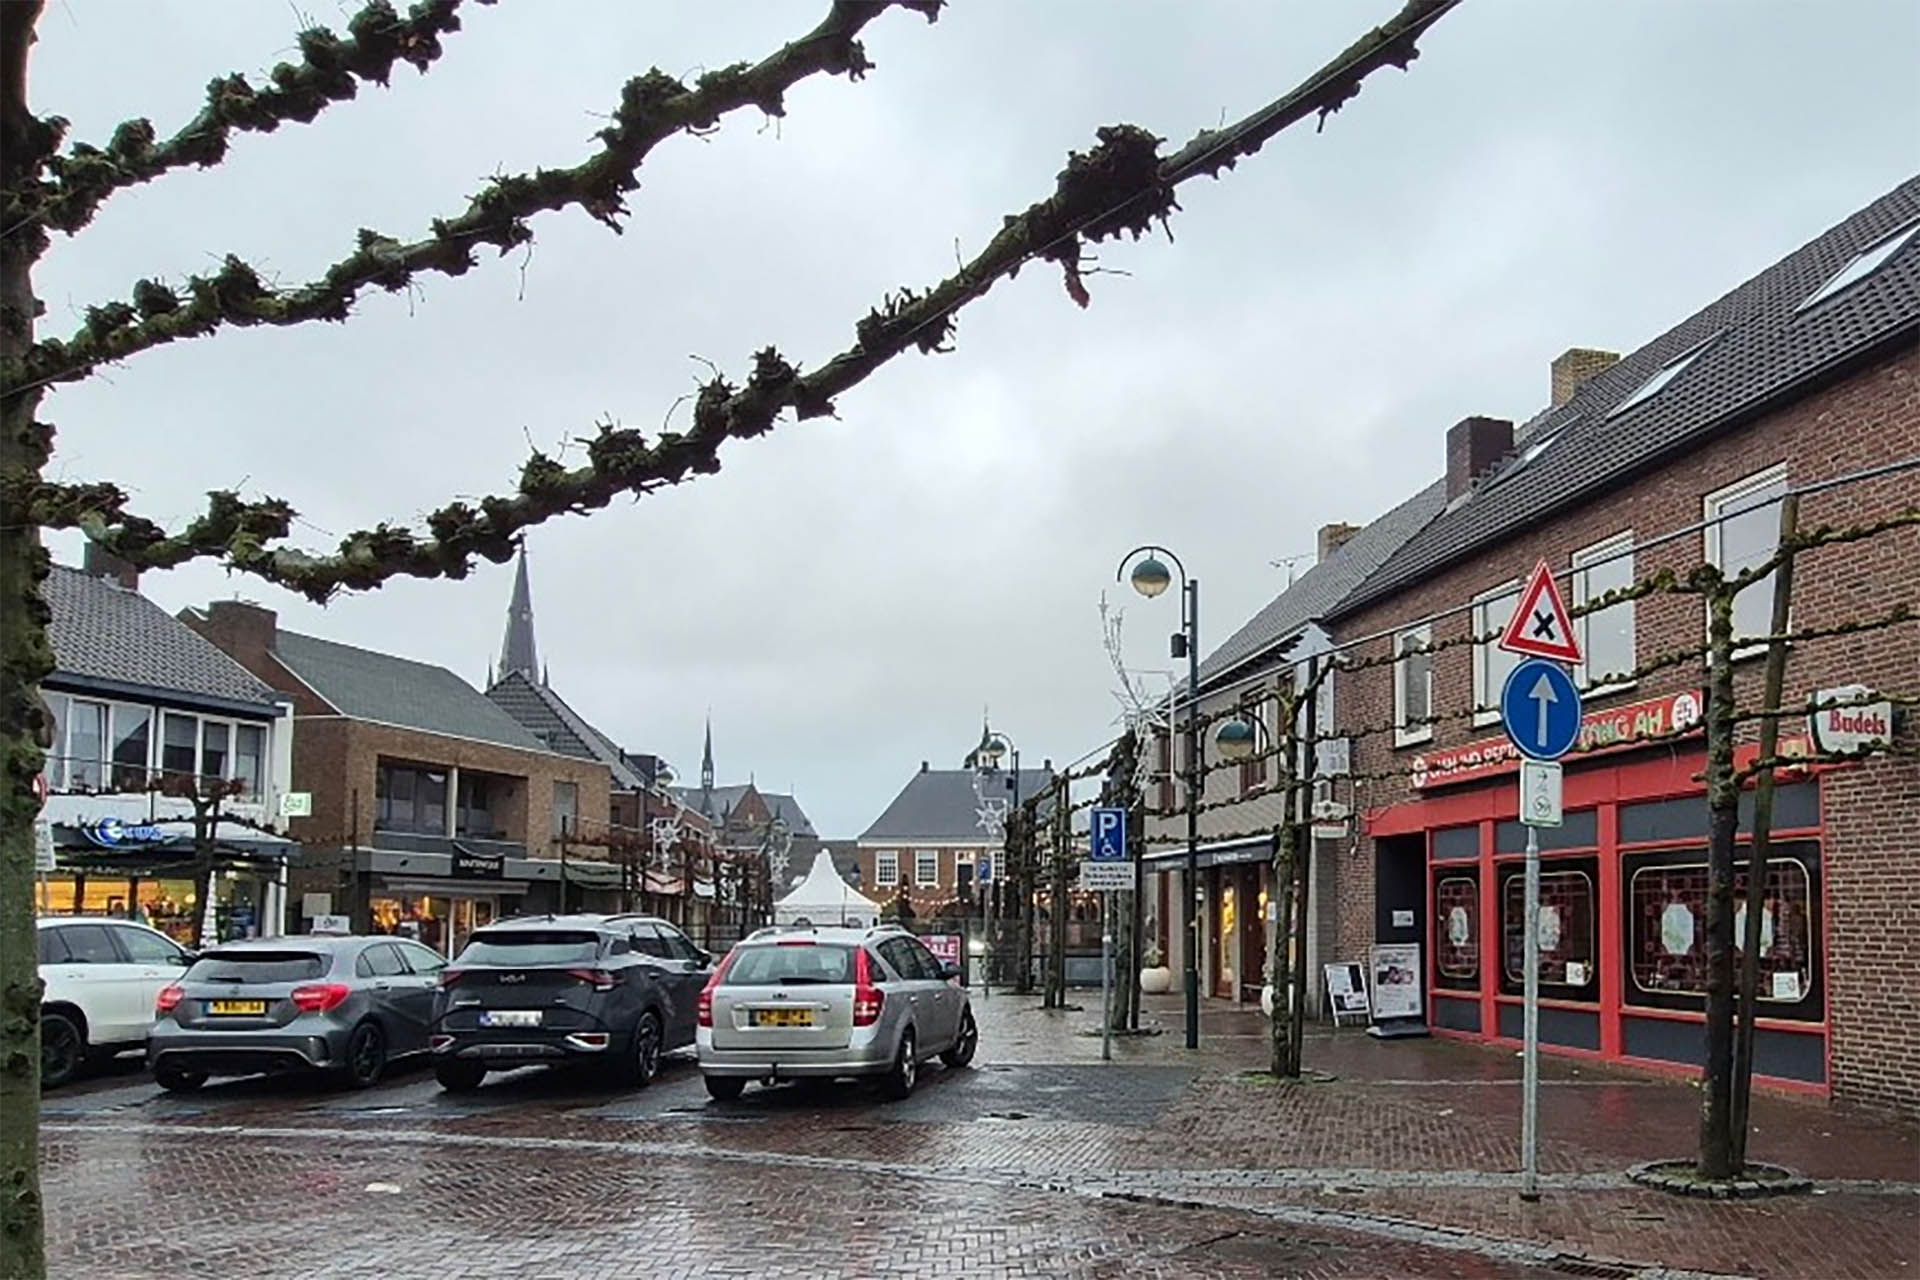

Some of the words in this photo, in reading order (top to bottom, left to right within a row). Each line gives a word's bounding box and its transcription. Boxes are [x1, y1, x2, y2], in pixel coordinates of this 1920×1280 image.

[1634, 706, 1664, 737] AH
[1828, 710, 1887, 736] Budels
[1099, 813, 1118, 839] P
